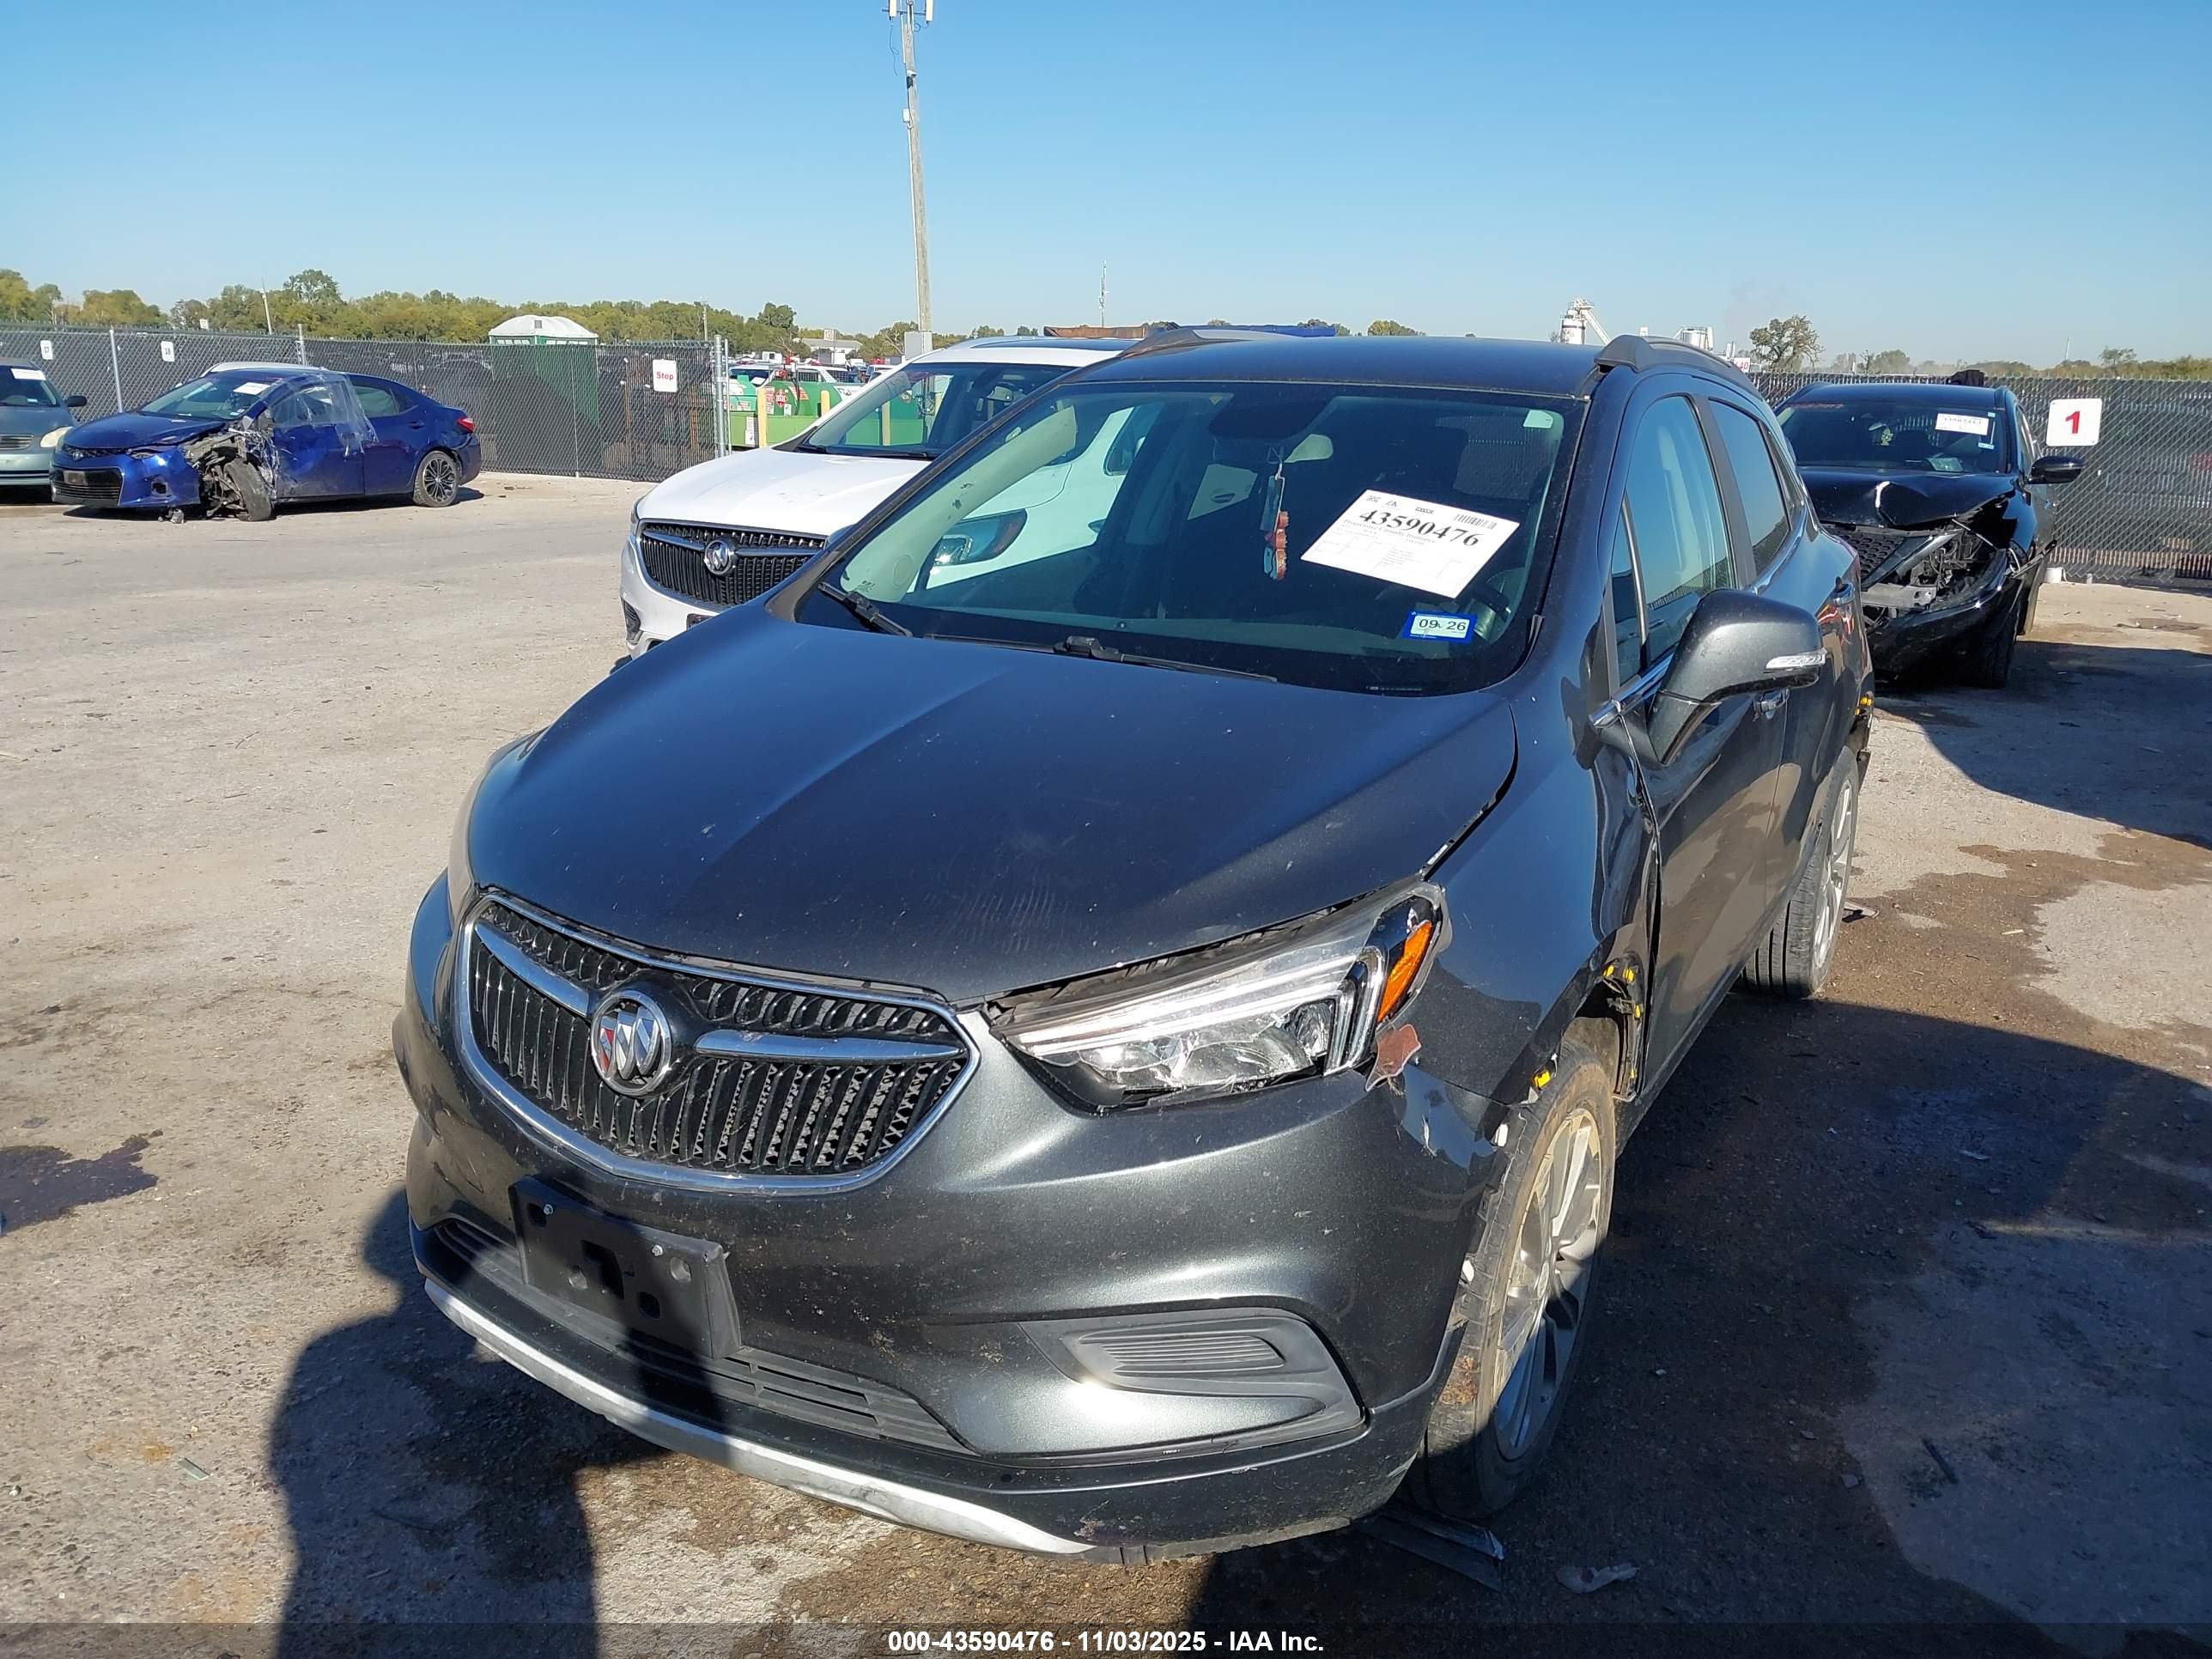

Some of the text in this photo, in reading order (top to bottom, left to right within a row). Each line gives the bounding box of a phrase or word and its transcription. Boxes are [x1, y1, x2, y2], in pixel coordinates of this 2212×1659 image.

[656, 371, 674, 382] Stop
[2065, 410, 2081, 434] 1
[1359, 509, 1486, 547] 43590476
[1419, 618, 1467, 631] 09 26
